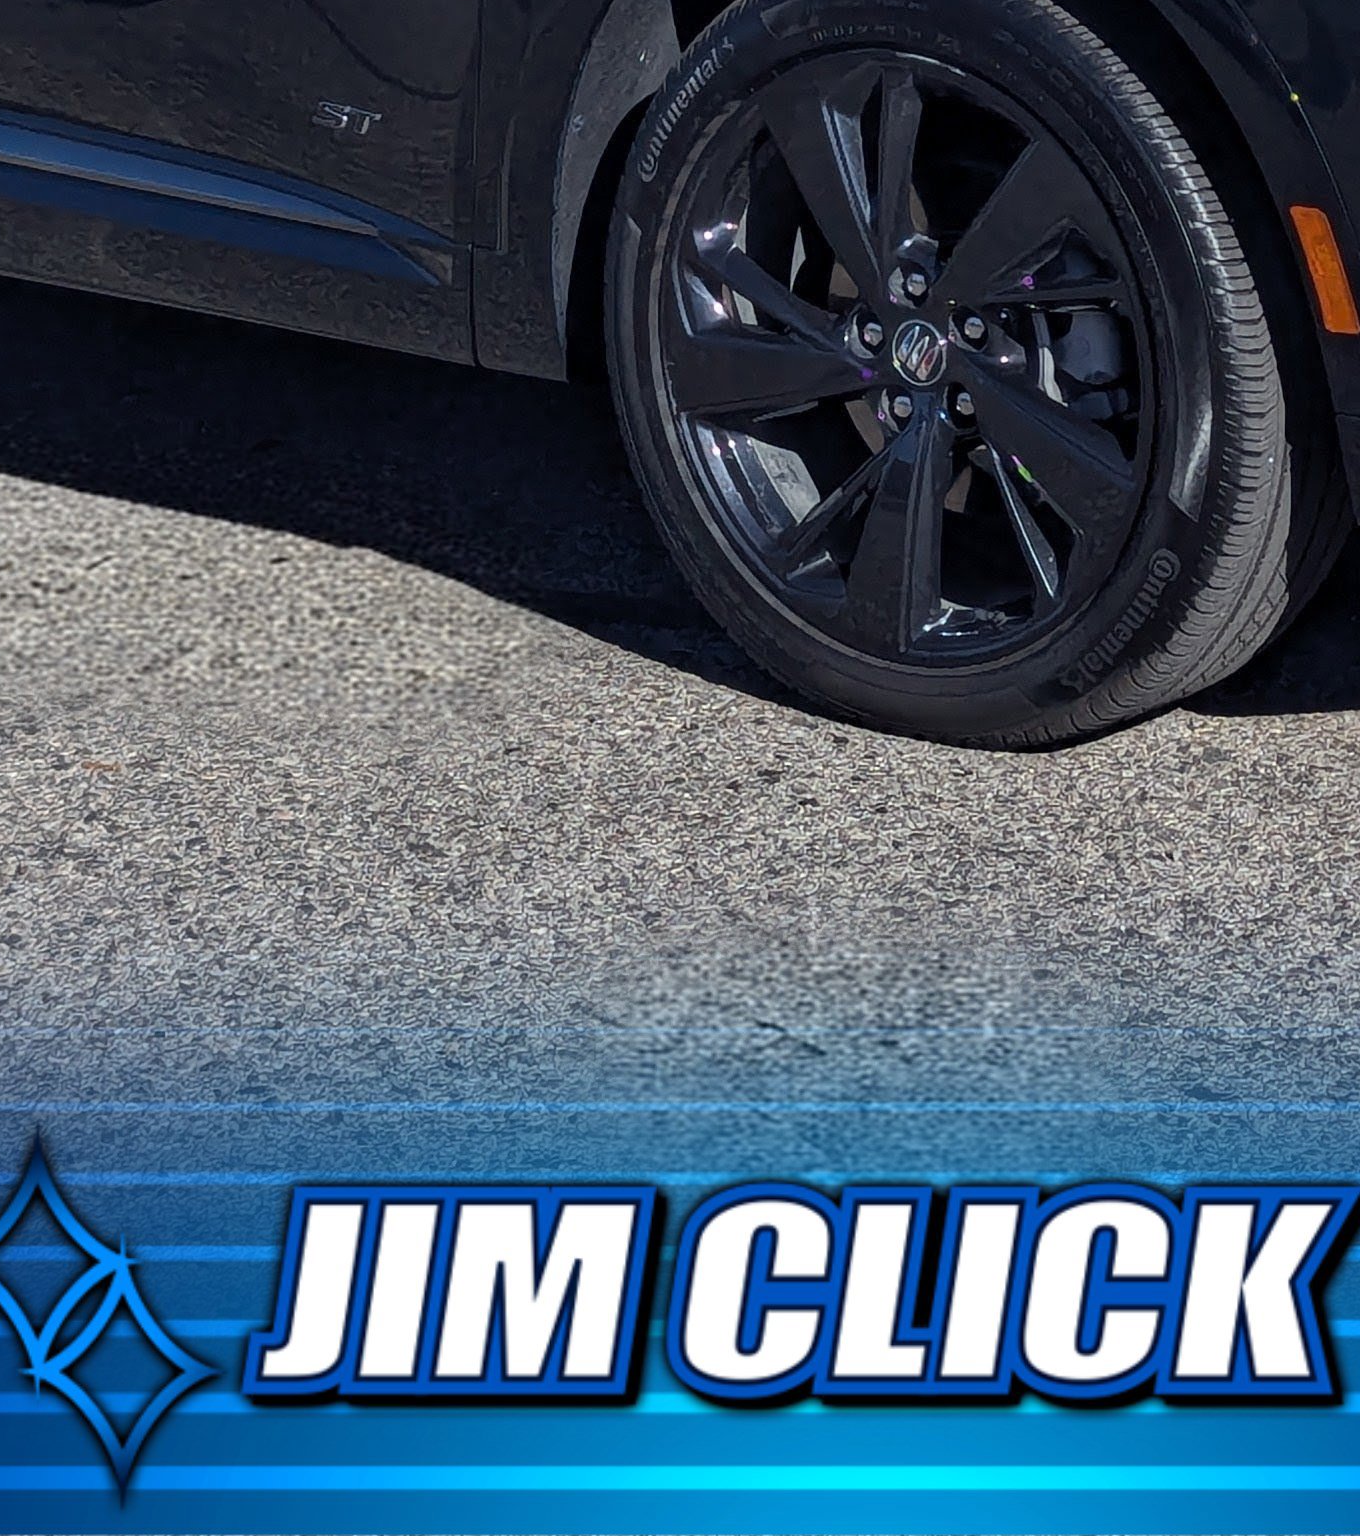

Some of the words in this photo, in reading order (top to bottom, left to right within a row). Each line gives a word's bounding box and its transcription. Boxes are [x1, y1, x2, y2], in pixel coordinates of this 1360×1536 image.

[311, 101, 382, 135] ST
[637, 47, 723, 183] Continental
[1078, 547, 1181, 683] Continental
